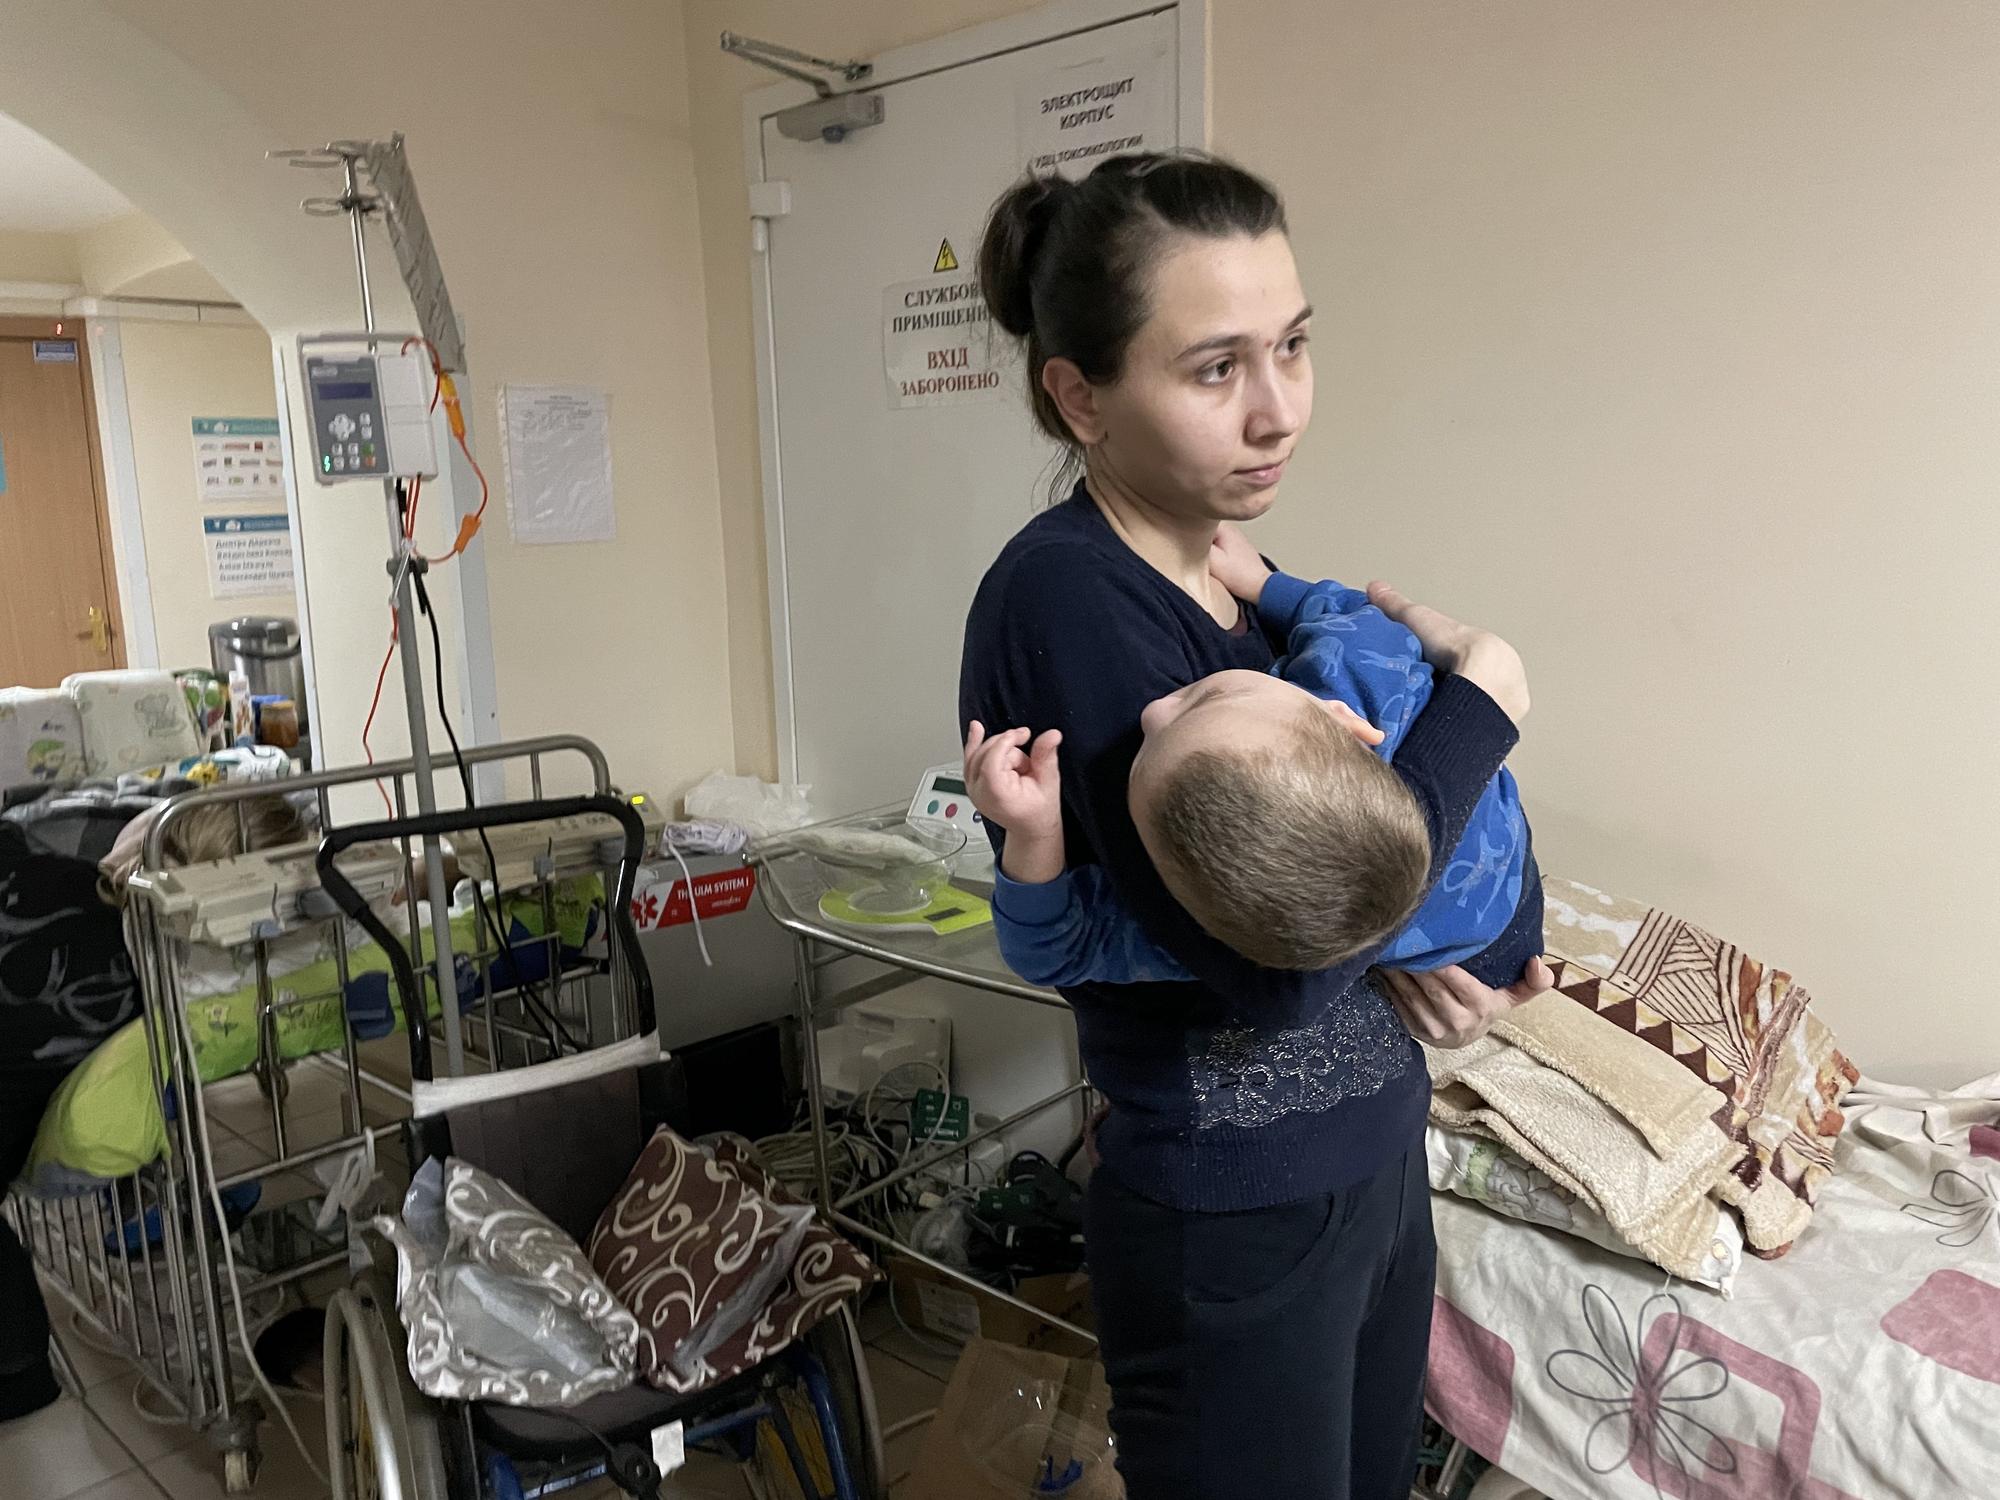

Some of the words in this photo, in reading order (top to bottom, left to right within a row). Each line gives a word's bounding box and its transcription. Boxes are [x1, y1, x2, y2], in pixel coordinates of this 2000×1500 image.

[1040, 77, 1135, 114] ЭЛЕКТРОЩИТ
[1059, 104, 1115, 130] КОРПУС
[904, 282, 979, 308] СЛУЖБОВ
[892, 306, 988, 333] ПРИМІЩЕНН
[927, 347, 969, 369] ВХІД
[900, 372, 999, 396] ЗАБОРОНЕНО
[713, 877, 745, 893] SYSTEM
